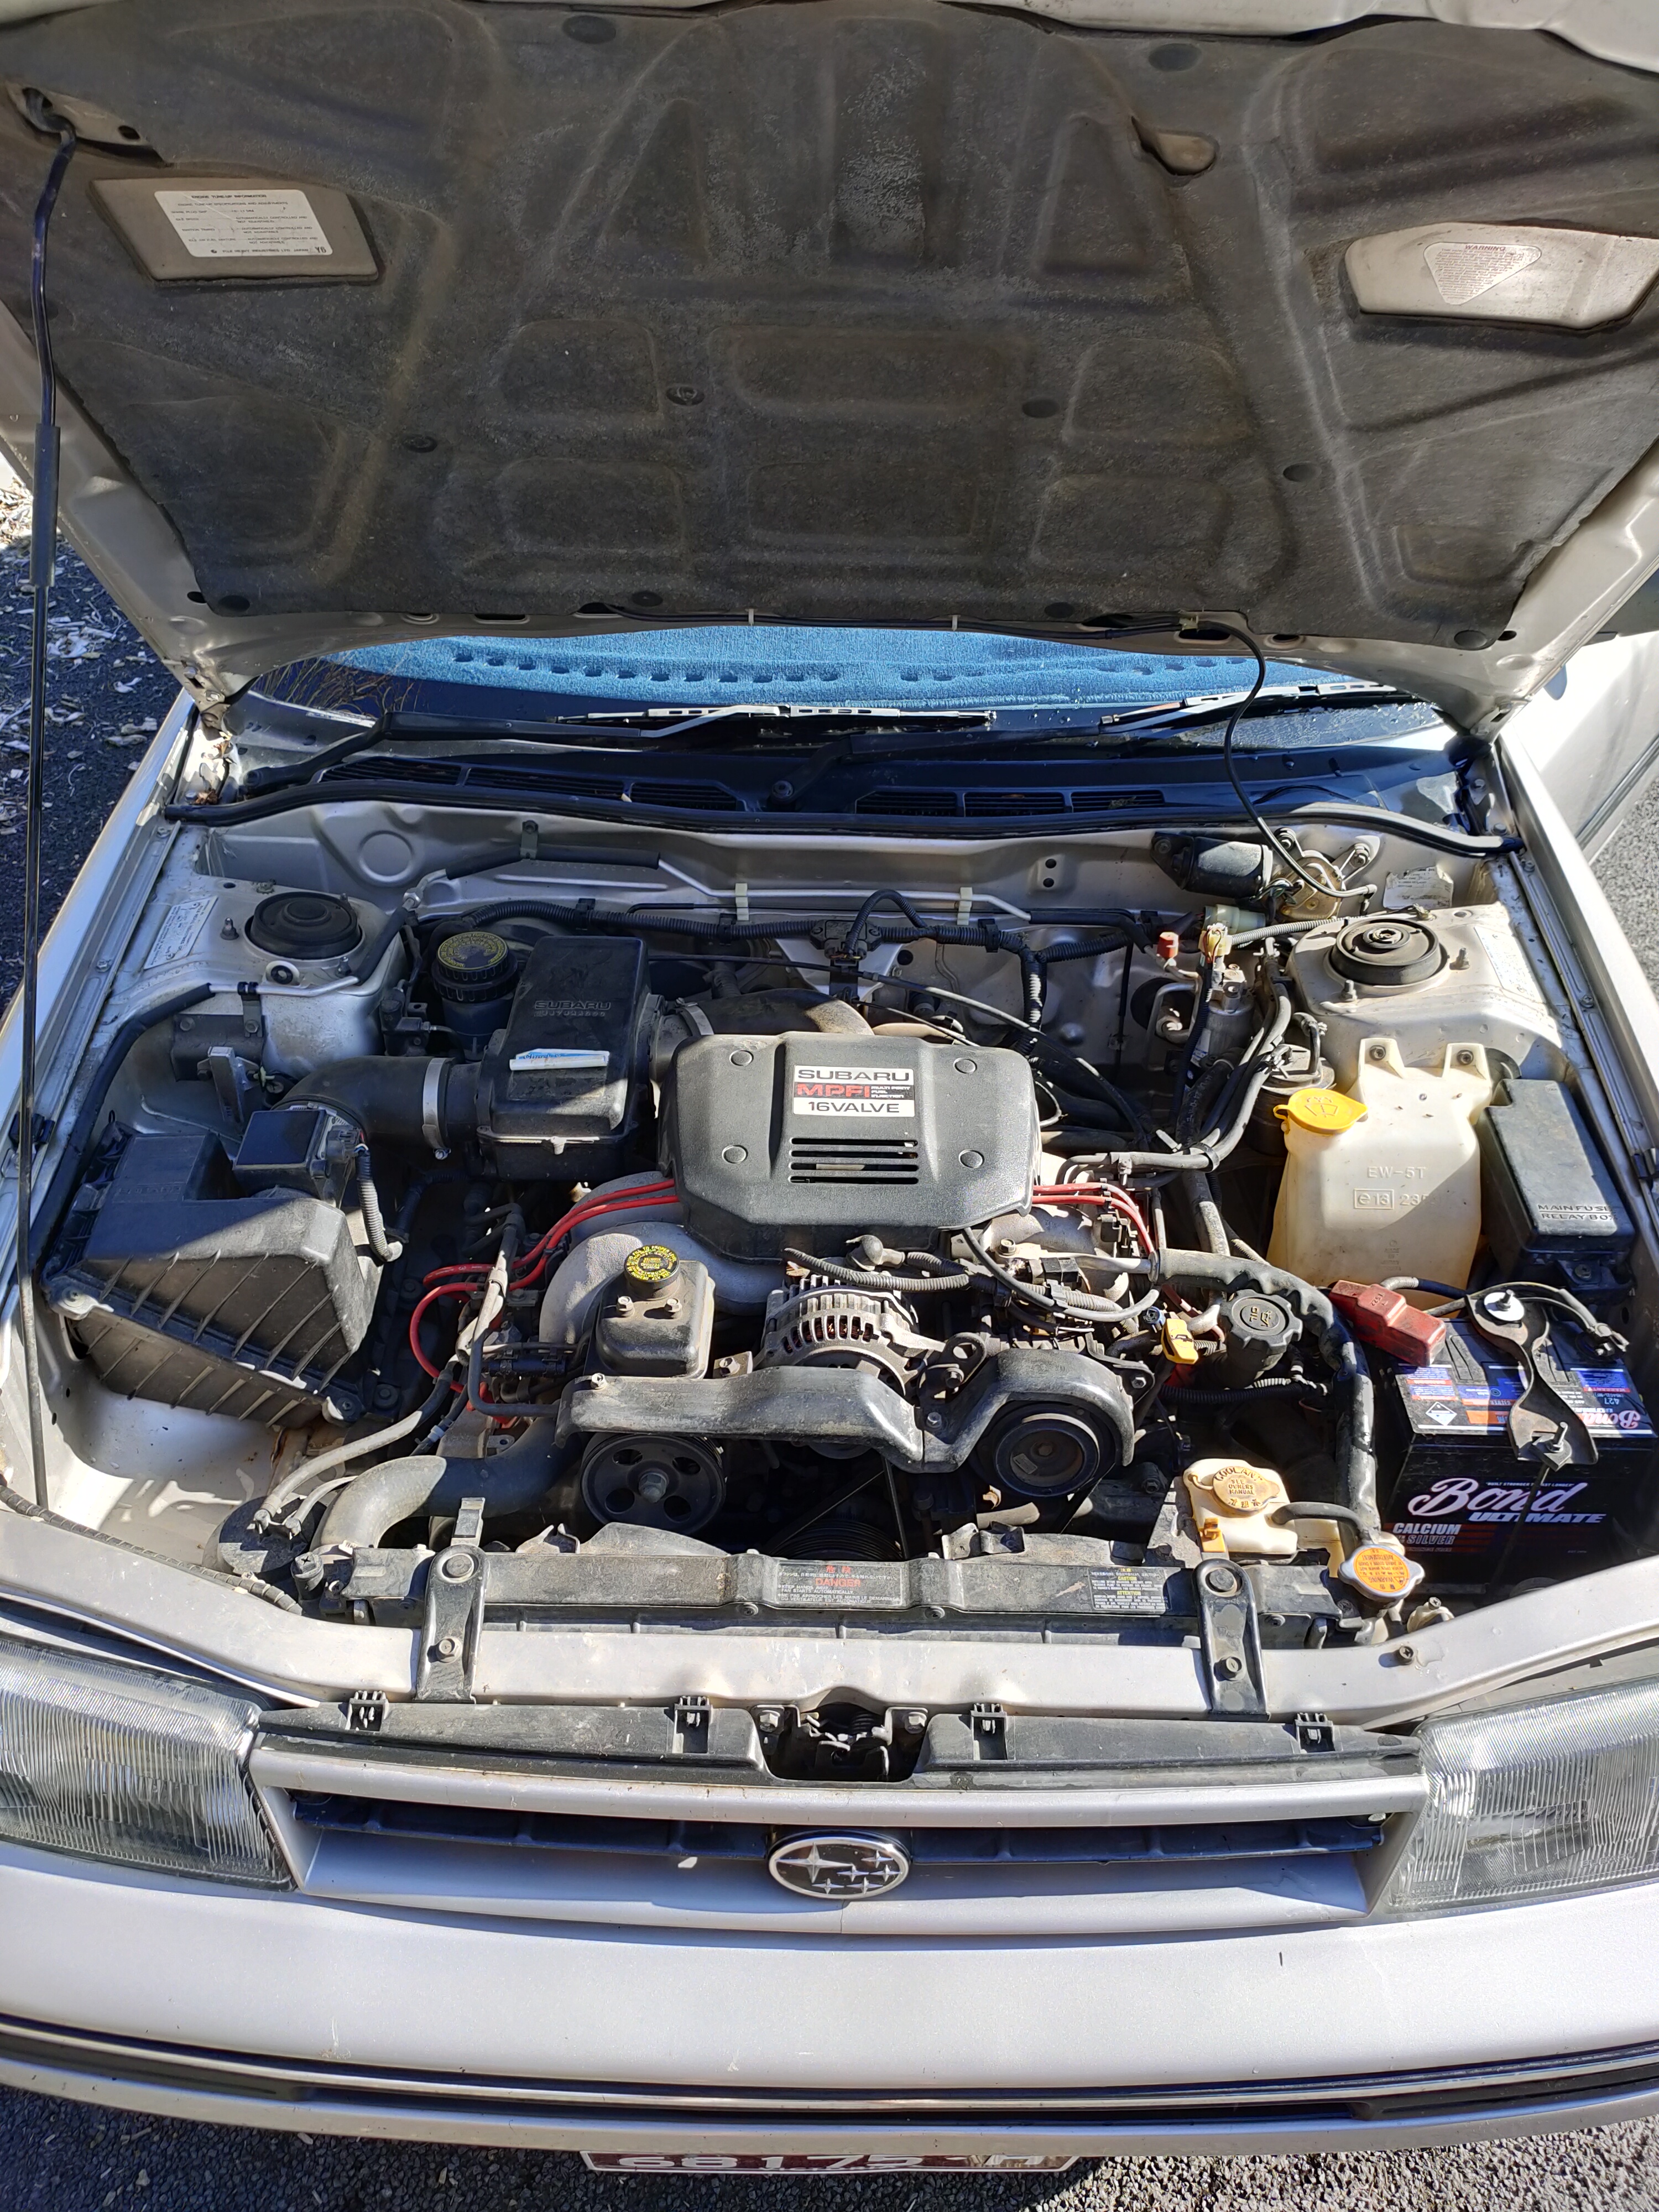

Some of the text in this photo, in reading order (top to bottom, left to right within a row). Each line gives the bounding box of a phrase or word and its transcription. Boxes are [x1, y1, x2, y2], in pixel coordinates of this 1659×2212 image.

[534, 1000, 612, 1010] SUBARU
[797, 1069, 909, 1082] SUBARU
[797, 1083, 870, 1098] MPFI
[807, 1101, 900, 1113] 16VALVE
[1367, 1166, 1426, 1179] EW-5T
[1249, 1306, 1258, 1322] OIL
[1213, 1467, 1264, 1481] COOLANT
[1407, 1477, 1589, 1517] Bond
[1392, 1522, 1462, 1535] CALCIUM
[1406, 1535, 1456, 1545] SILVER
[815, 1578, 862, 1588] DANGER
